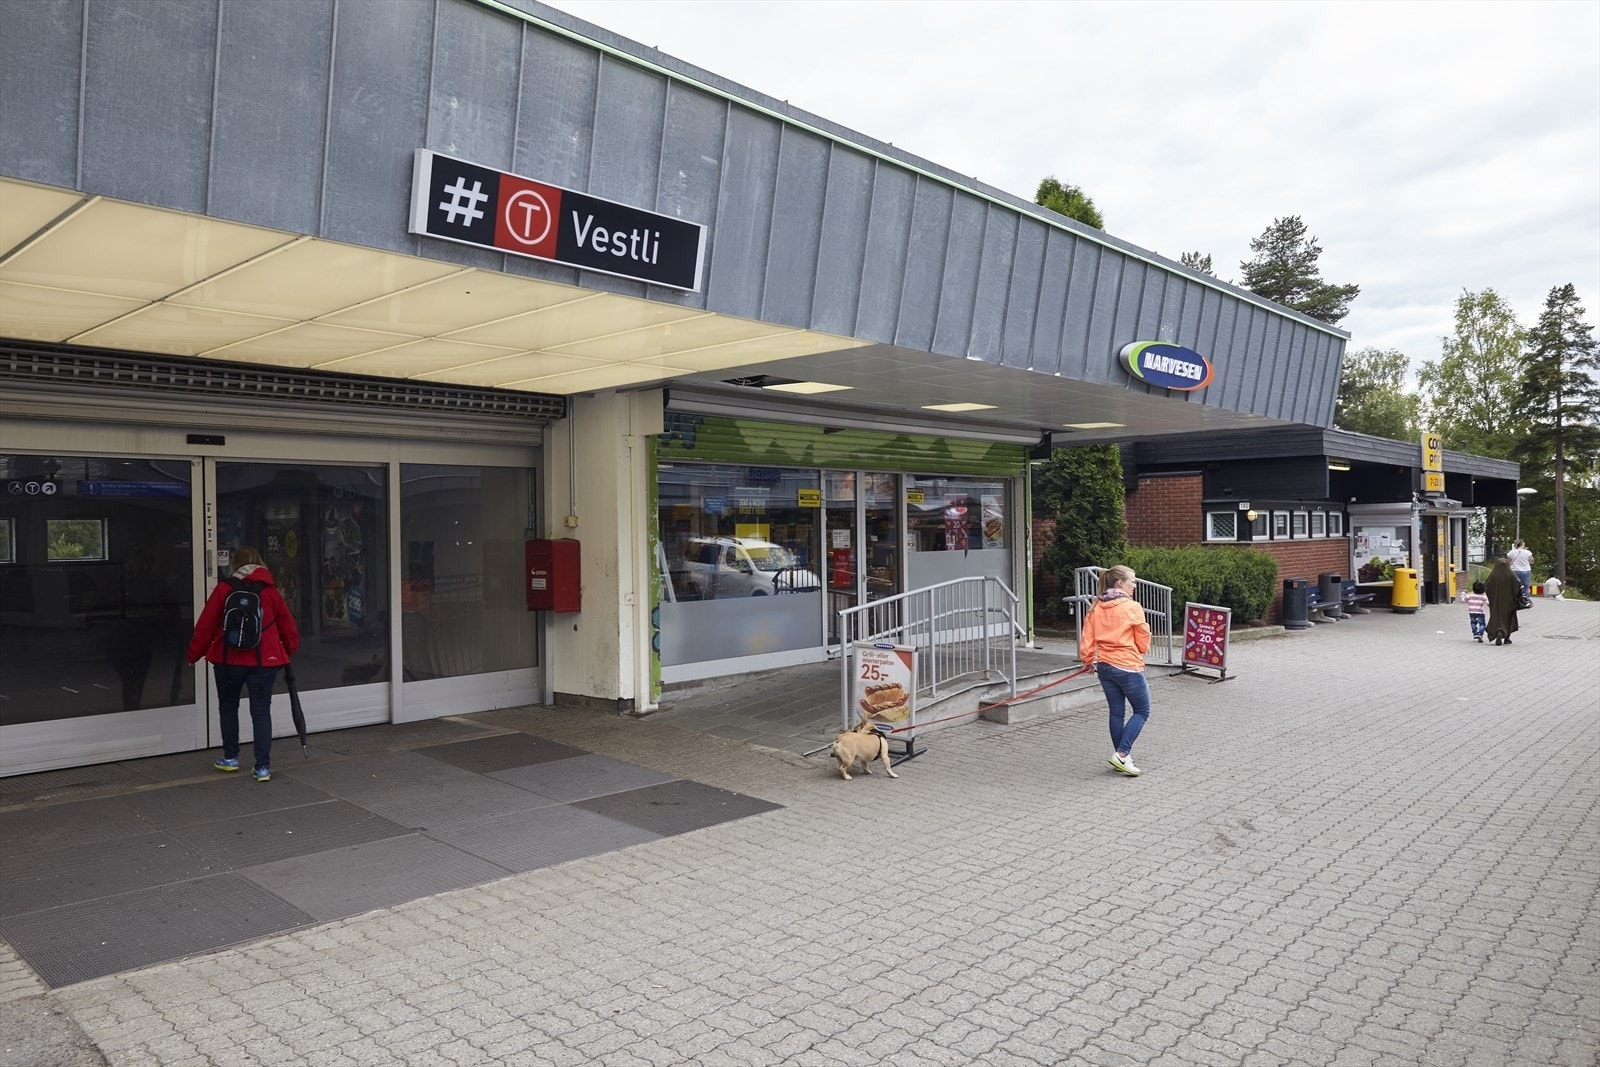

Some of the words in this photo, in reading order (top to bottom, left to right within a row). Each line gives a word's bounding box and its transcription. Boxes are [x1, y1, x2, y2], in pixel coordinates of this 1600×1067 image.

[572, 210, 661, 265] Vestli
[1143, 352, 1203, 381] NARVESEN
[862, 650, 876, 658] Grill-
[862, 657, 895, 666] wienerpølse
